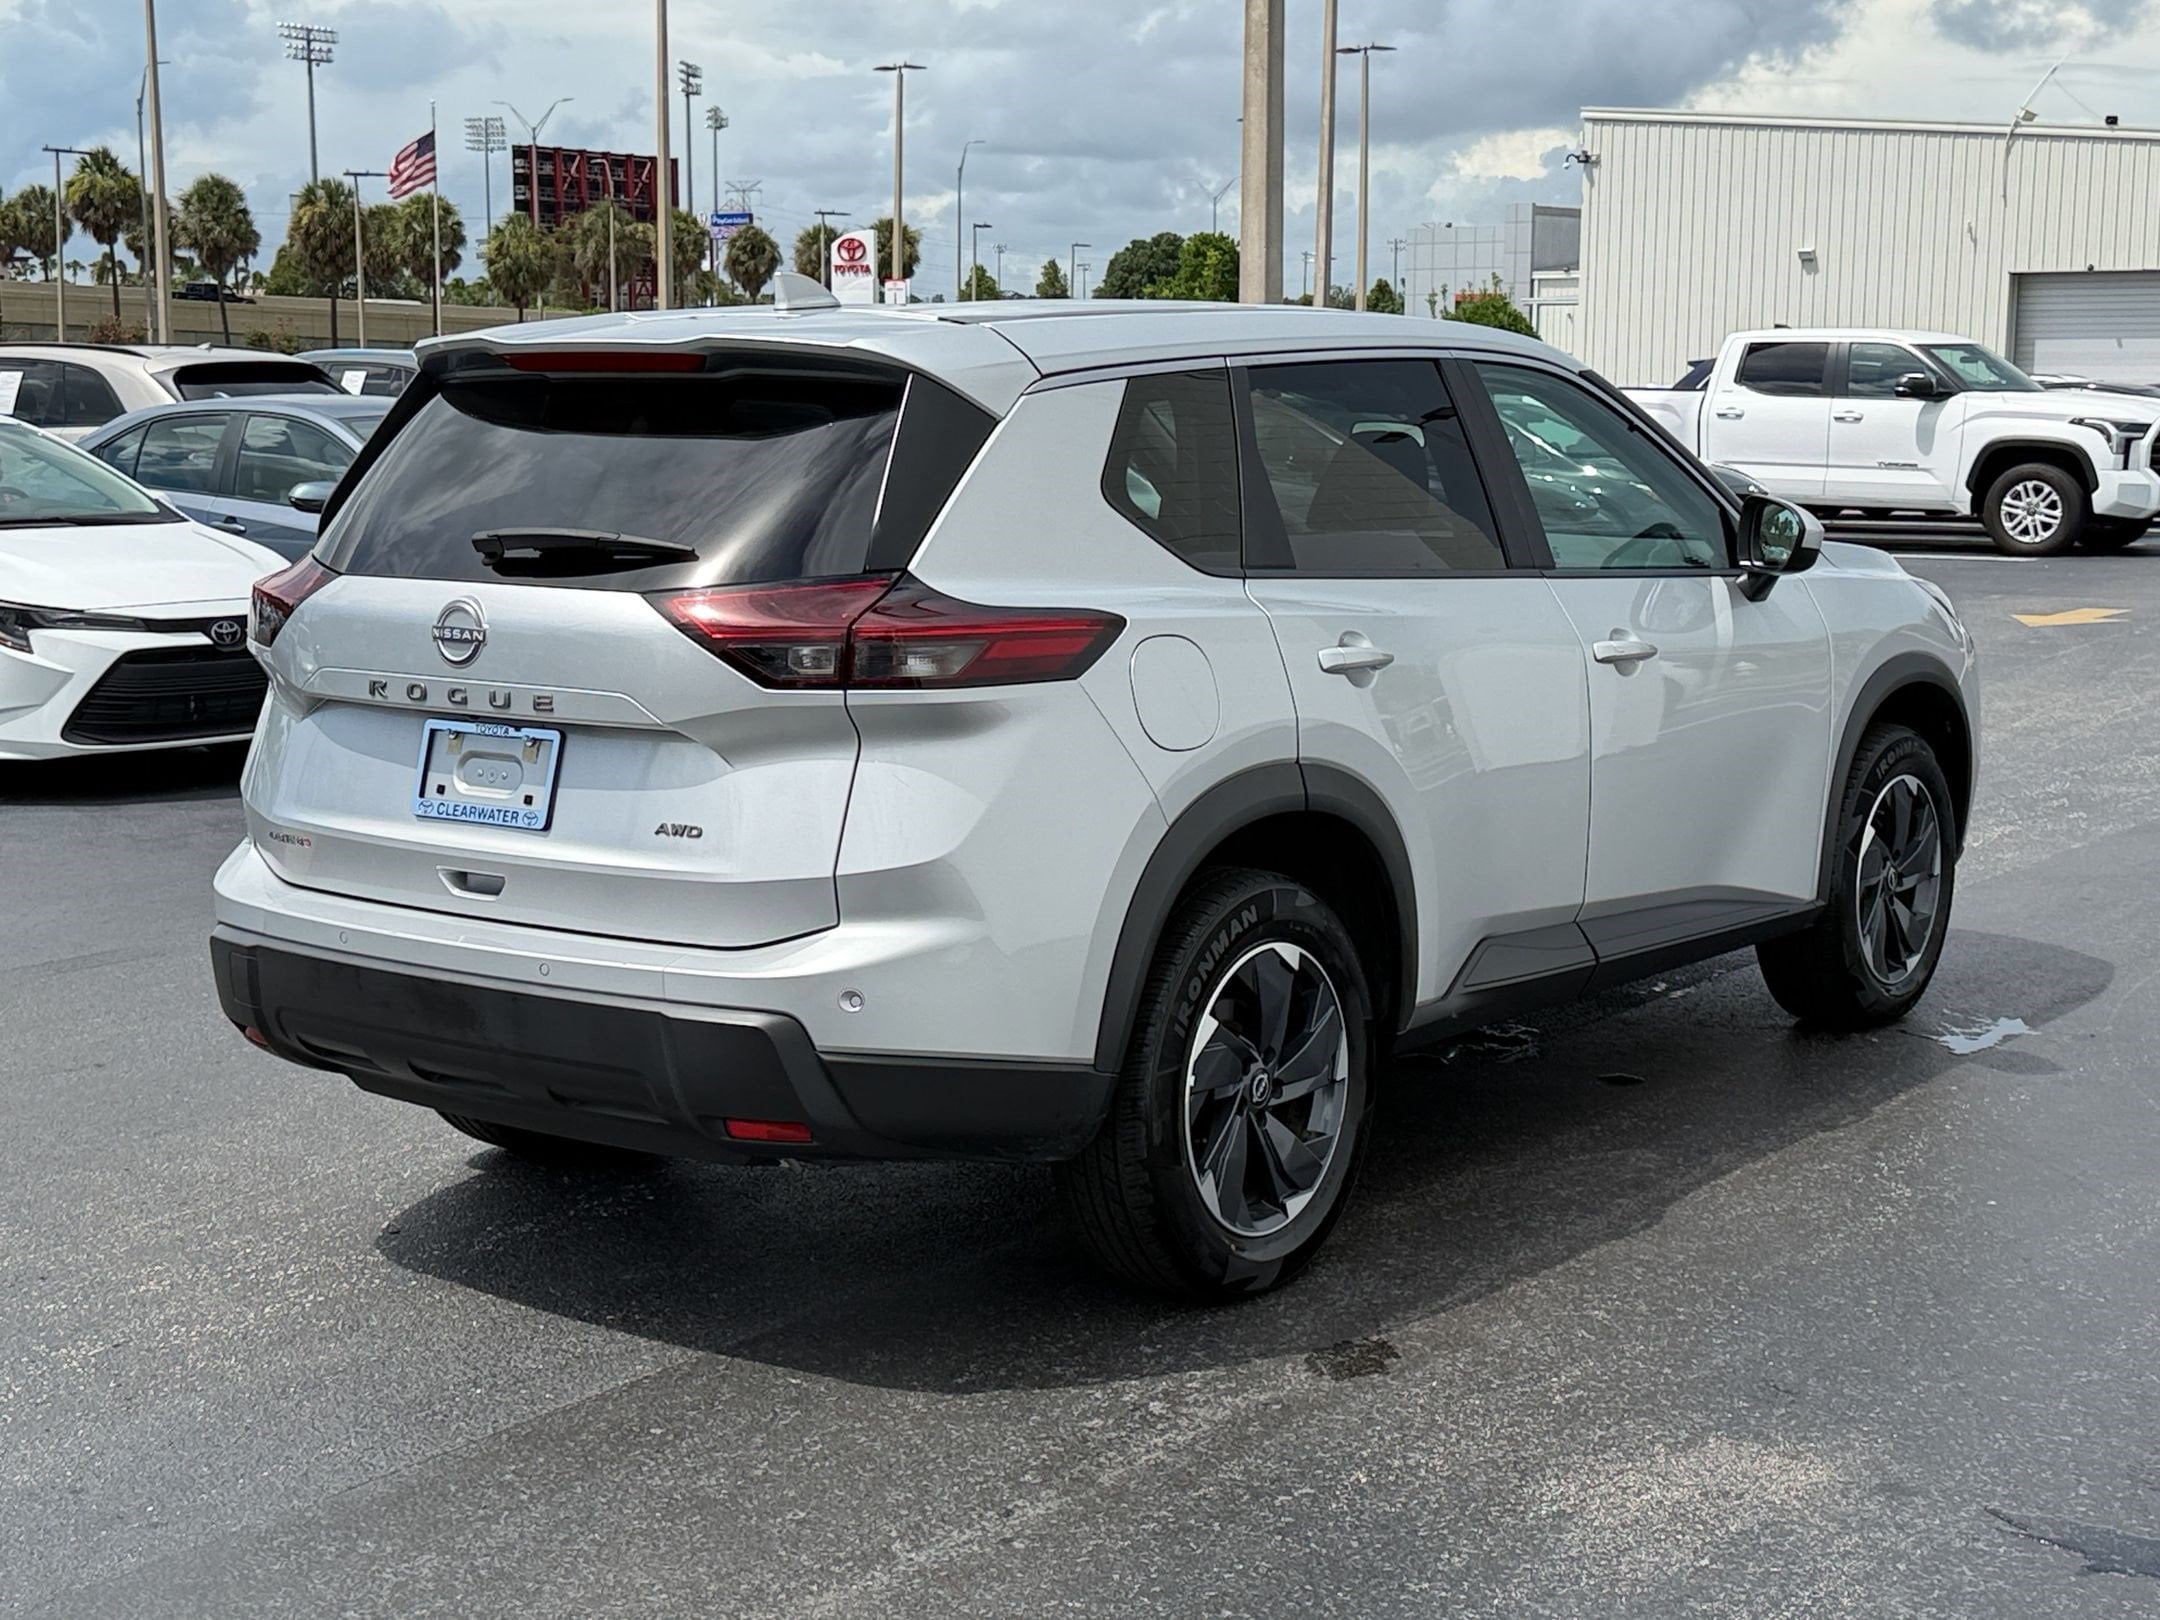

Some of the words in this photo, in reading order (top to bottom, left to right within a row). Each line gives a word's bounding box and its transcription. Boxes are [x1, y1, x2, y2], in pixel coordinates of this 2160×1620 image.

[833, 264, 872, 275] TOYOTA
[432, 627, 484, 641] NISSAN
[368, 680, 554, 712] ROGUE
[475, 723, 511, 737] TOYOTA
[436, 802, 520, 825] CLEARWATER
[654, 822, 703, 839] AWD
[1174, 904, 1258, 1039] IRONMAN
